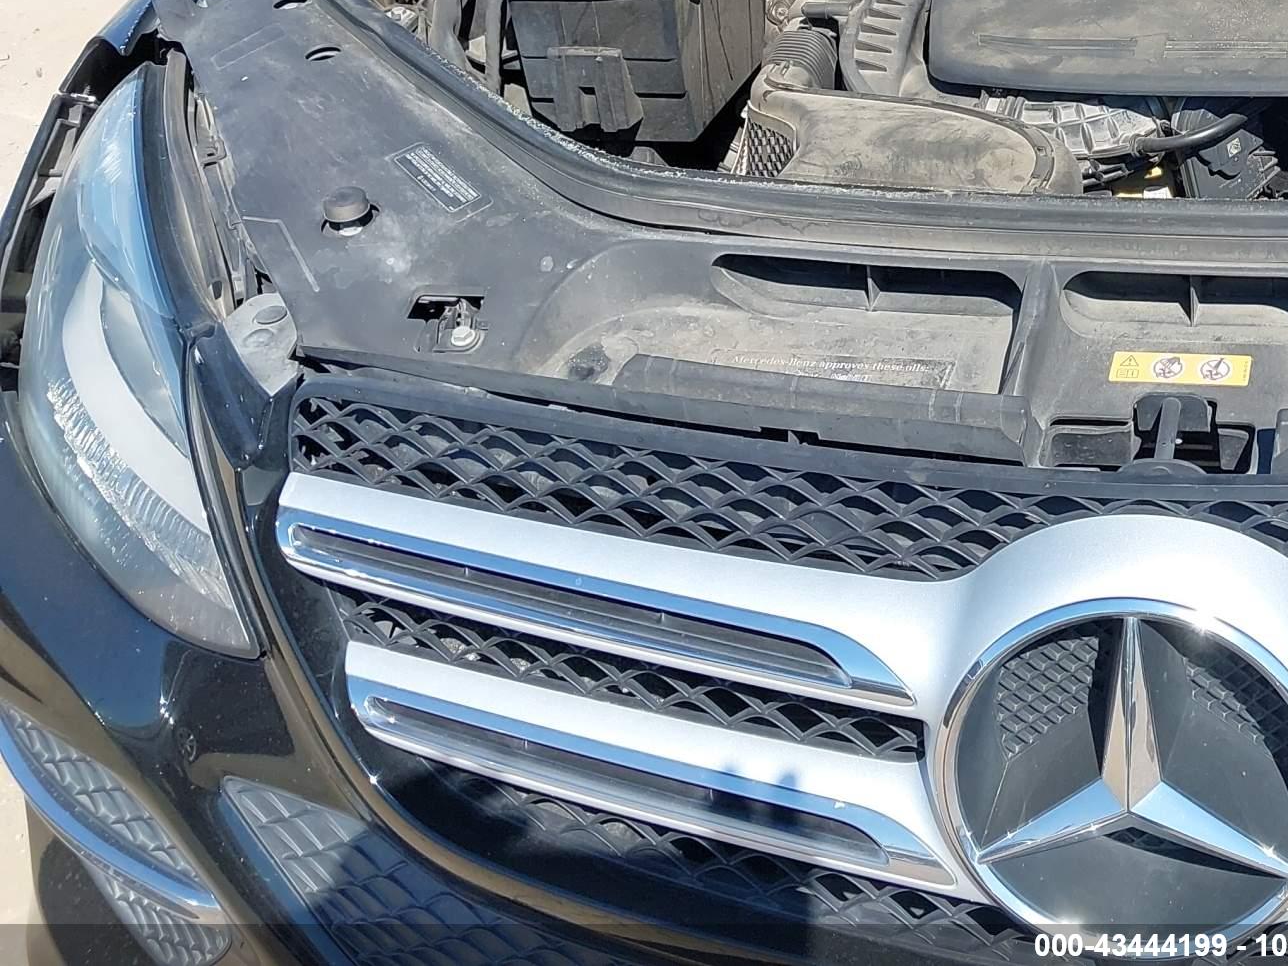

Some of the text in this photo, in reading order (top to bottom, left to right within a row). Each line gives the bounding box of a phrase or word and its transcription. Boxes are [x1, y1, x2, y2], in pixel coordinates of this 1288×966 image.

[732, 355, 817, 367] Mercedes-Benz
[819, 360, 869, 370] approves
[872, 362, 903, 371] these
